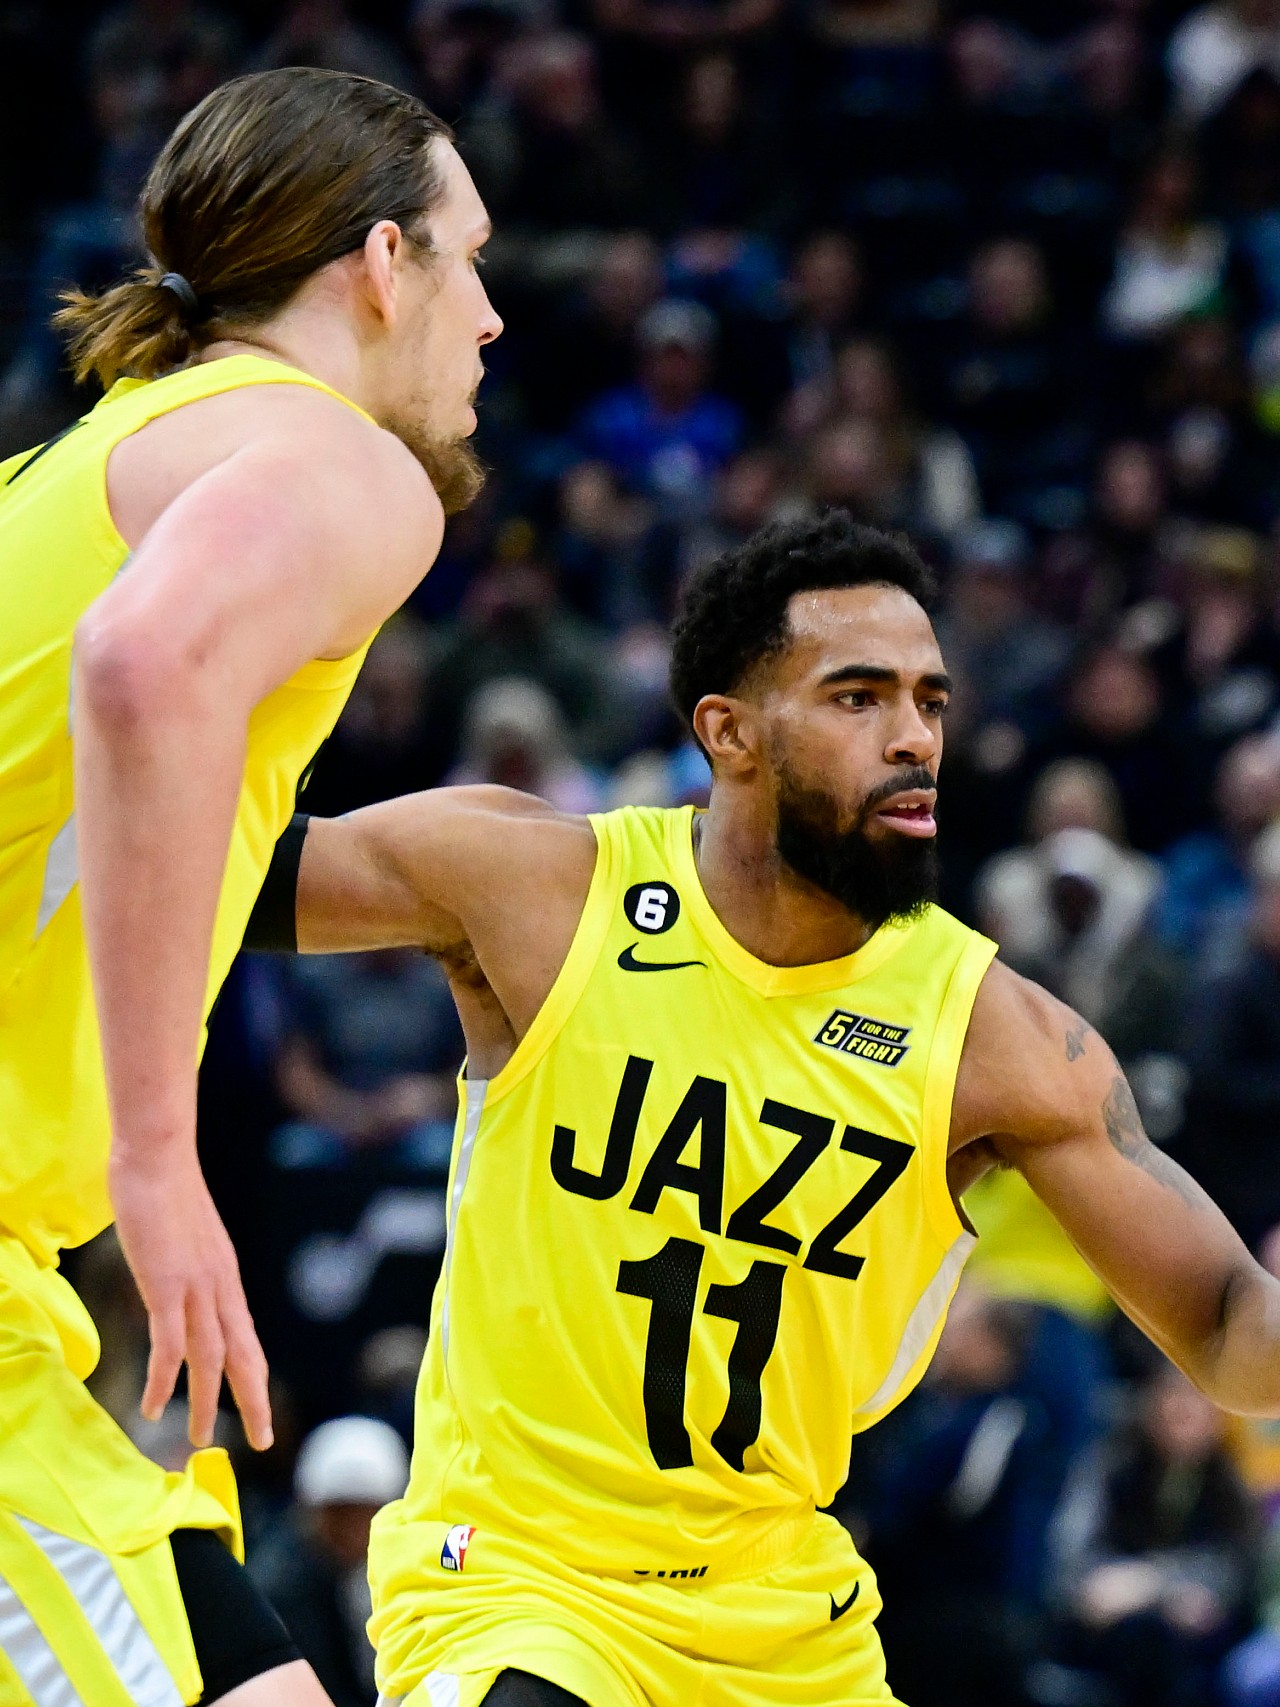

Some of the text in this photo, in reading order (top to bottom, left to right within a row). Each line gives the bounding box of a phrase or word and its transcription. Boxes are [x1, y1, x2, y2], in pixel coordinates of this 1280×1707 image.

[634, 887, 669, 931] 6
[821, 1013, 854, 1046] 5
[860, 1021, 904, 1041] FOR THE
[846, 1036, 902, 1063] FIGHT
[549, 1054, 917, 1282] JAZZ
[615, 1236, 789, 1473] 11
